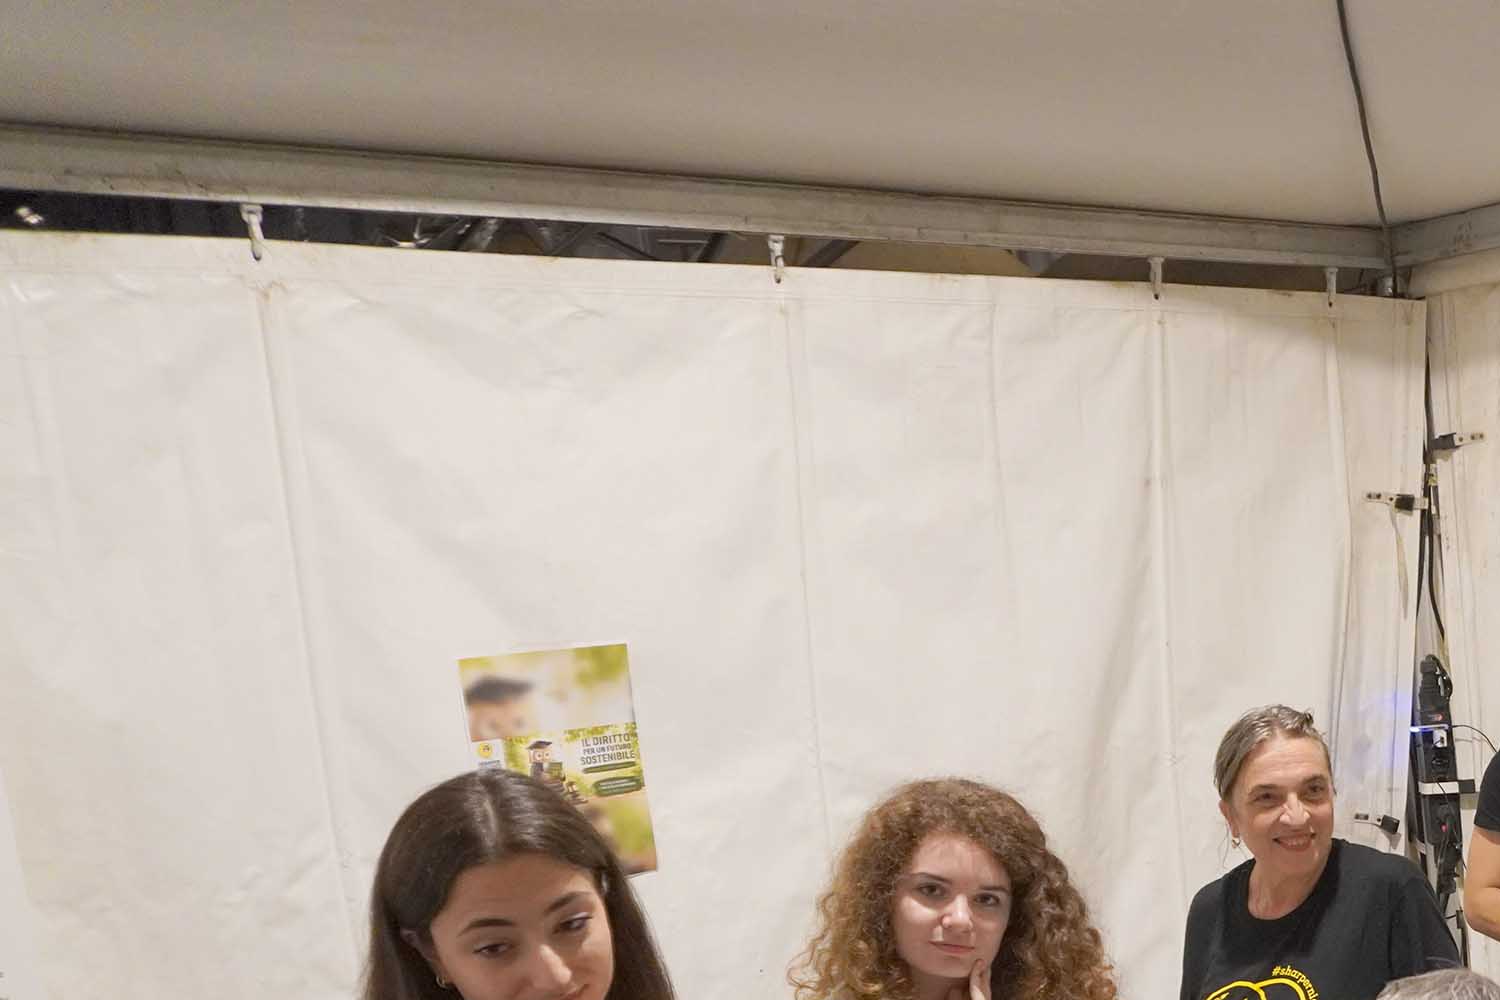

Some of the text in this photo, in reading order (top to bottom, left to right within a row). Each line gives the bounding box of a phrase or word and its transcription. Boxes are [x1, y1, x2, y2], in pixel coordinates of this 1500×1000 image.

[581, 733, 630, 747] IL DIRITTO
[580, 750, 636, 765] SOSTENIBILE
[583, 747, 595, 755] PER
